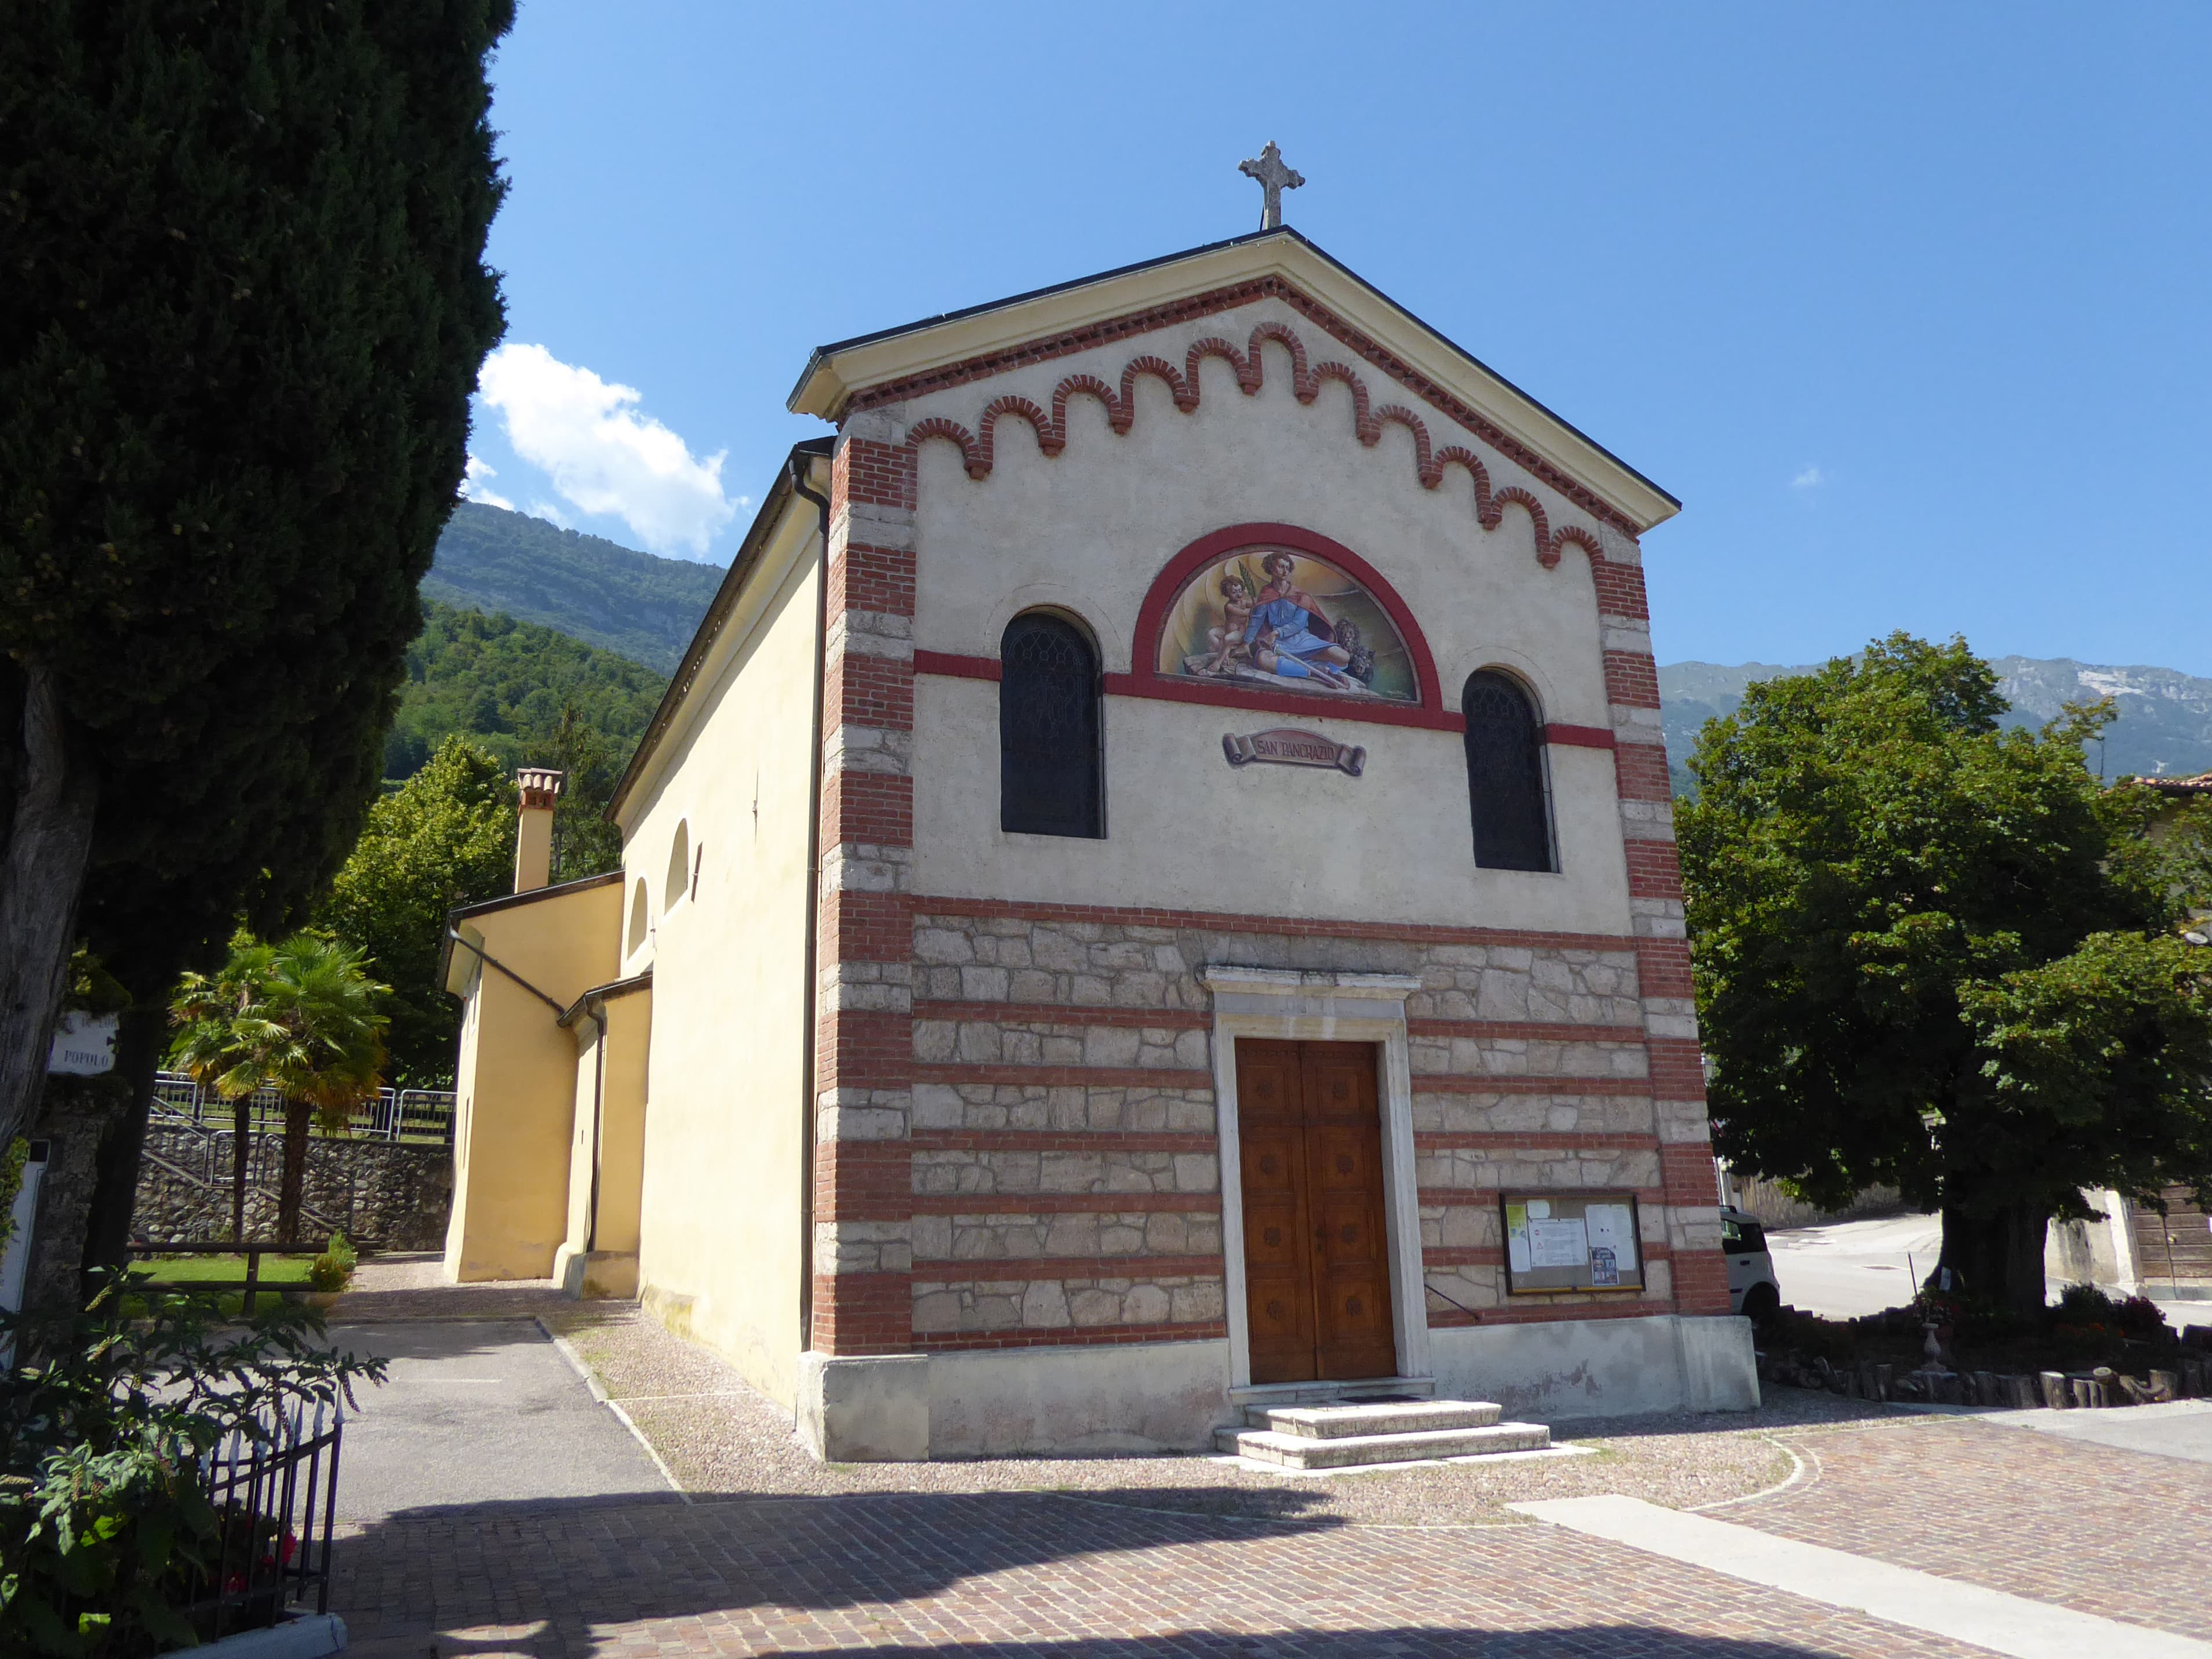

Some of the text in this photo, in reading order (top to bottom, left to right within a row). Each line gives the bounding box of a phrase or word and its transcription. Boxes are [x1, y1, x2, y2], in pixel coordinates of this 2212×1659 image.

[1257, 740, 1335, 761] SAN PANCRAZIO
[64, 1050, 108, 1067] POPOLO
